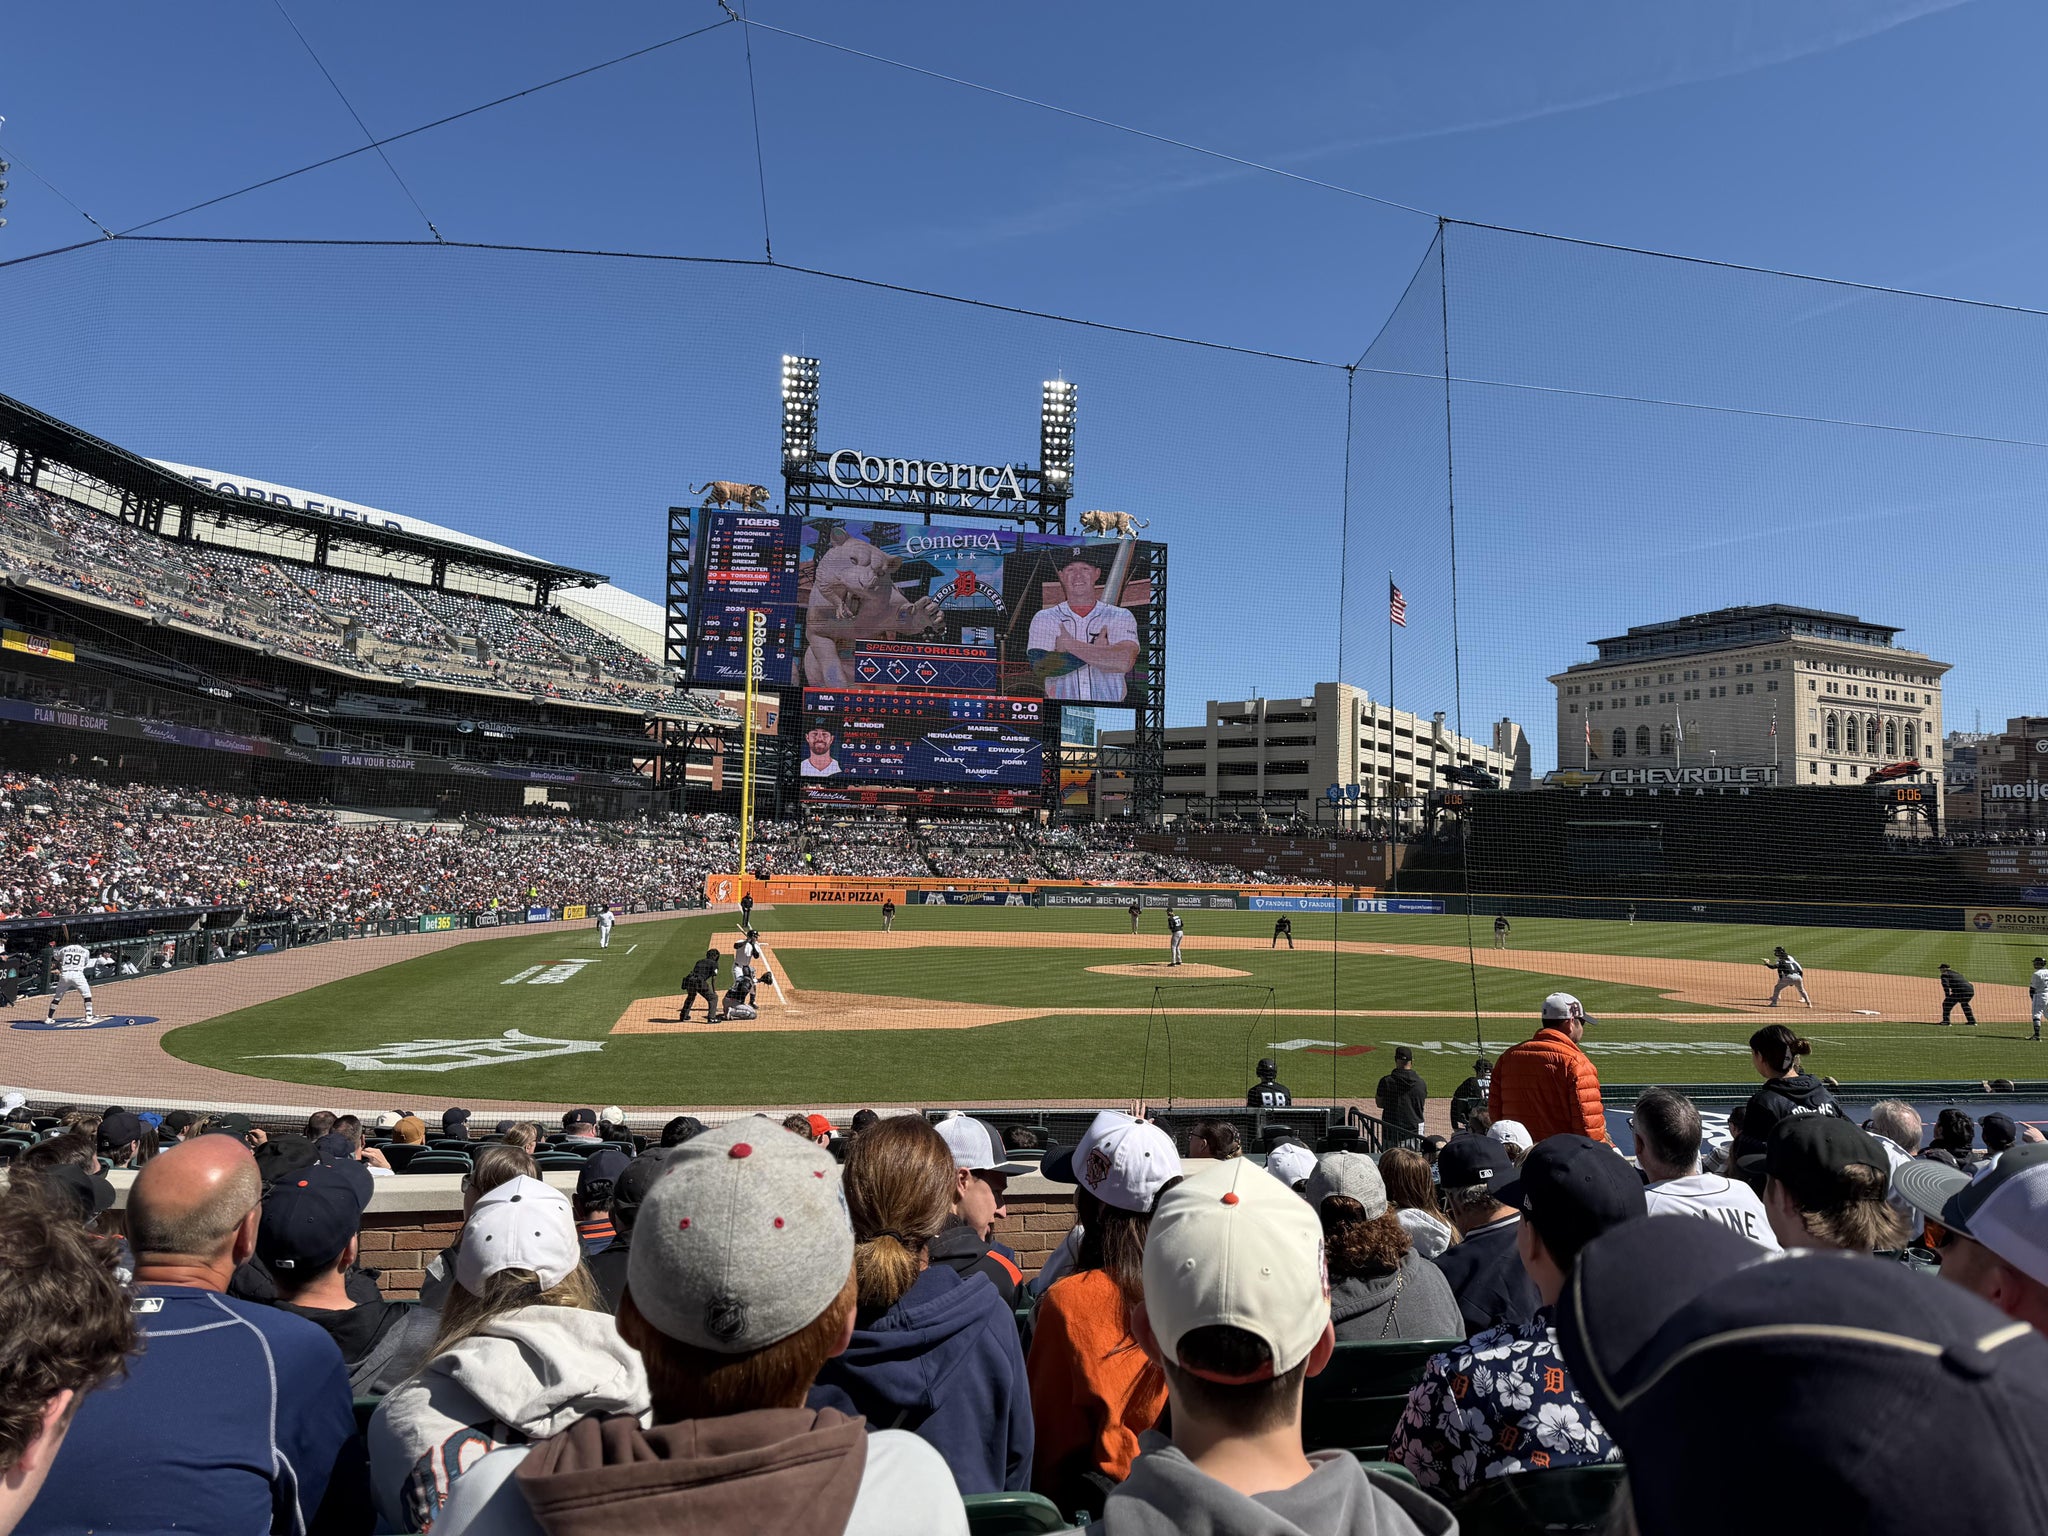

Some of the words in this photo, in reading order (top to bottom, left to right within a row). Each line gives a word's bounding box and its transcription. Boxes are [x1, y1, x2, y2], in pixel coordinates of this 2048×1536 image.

[884, 487, 973, 508] PARK
[736, 518, 780, 527] TIGERS
[934, 553, 977, 561] PARK
[933, 583, 955, 603] TROIT
[979, 583, 1005, 611] TIGERS
[865, 643, 914, 653] SPENCER
[915, 646, 987, 657] TORKELSON
[201, 675, 241, 693] CHAMPIONS
[1012, 703, 1038, 713] 0-0
[34, 708, 54, 723] PLAN
[56, 711, 78, 726] YOUR
[79, 715, 108, 731] ESCAPE
[477, 720, 522, 734] Gallagher
[483, 730, 514, 740] INSURANCE
[341, 755, 362, 766] PLAN
[363, 757, 385, 768] YOUR
[386, 757, 416, 769] ESCAPE
[965, 767, 999, 775] RAMÍREZ
[1610, 766, 1778, 784] CHEVROLET
[1579, 786, 1750, 797] FOUNTAIN
[1176, 837, 1187, 846] 23
[1289, 840, 1295, 849] 2
[1267, 855, 1277, 864] 47
[1308, 857, 1314, 866] 3
[809, 891, 845, 902] PIZZA!
[847, 892, 884, 902] PIZZA!
[1055, 896, 1092, 904] BETMGM
[1103, 896, 1139, 905] BETMGM
[1357, 900, 1388, 912] DTE
[425, 920, 450, 931] bet365
[64, 953, 82, 966] 39
